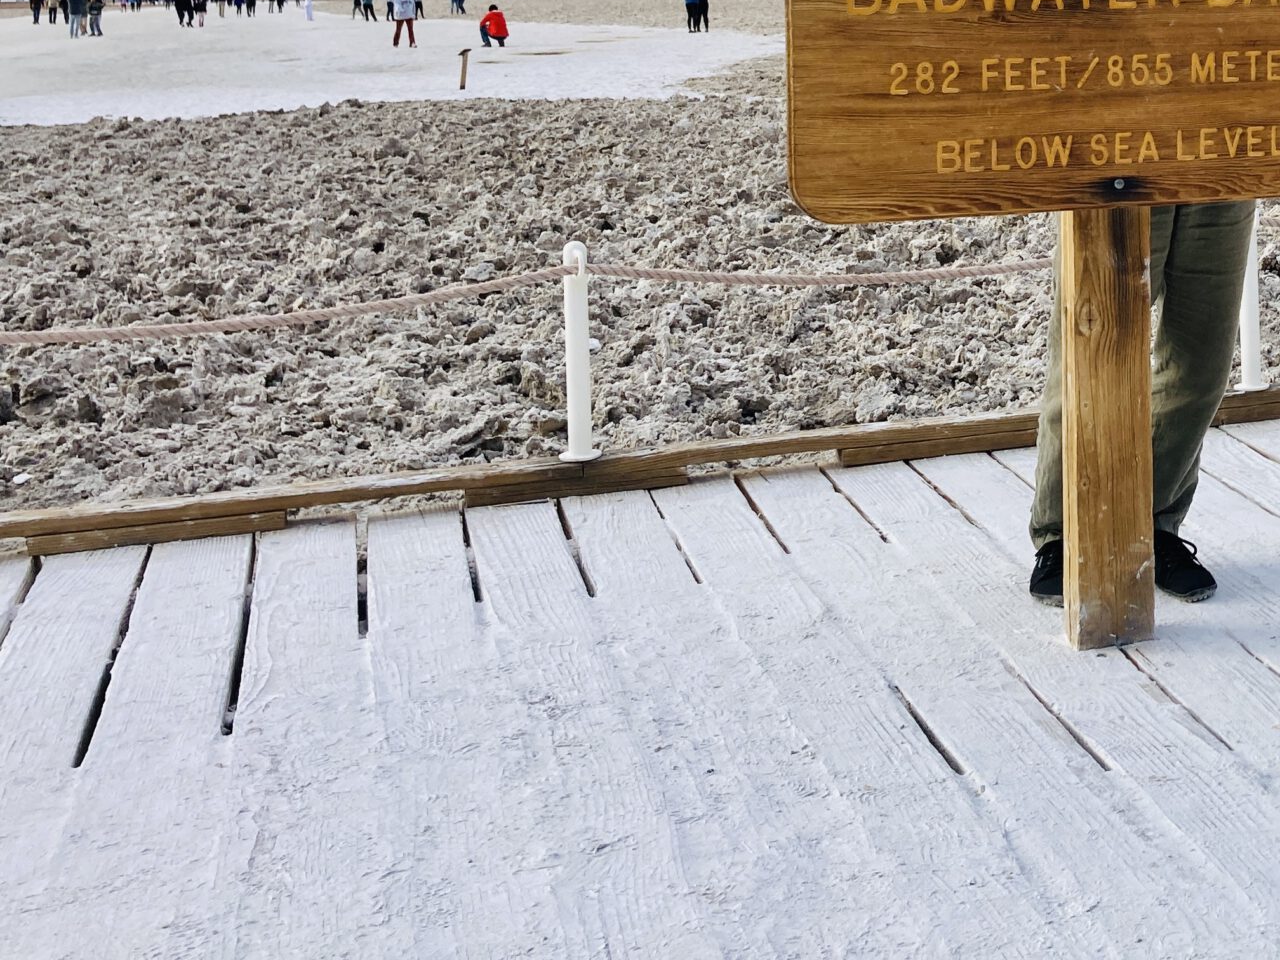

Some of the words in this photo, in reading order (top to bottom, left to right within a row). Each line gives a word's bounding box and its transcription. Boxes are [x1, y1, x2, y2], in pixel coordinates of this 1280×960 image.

[889, 60, 960, 95] 282
[982, 53, 1173, 92] FEET/855
[936, 135, 1073, 174] BELOW
[1090, 132, 1159, 166] SEA
